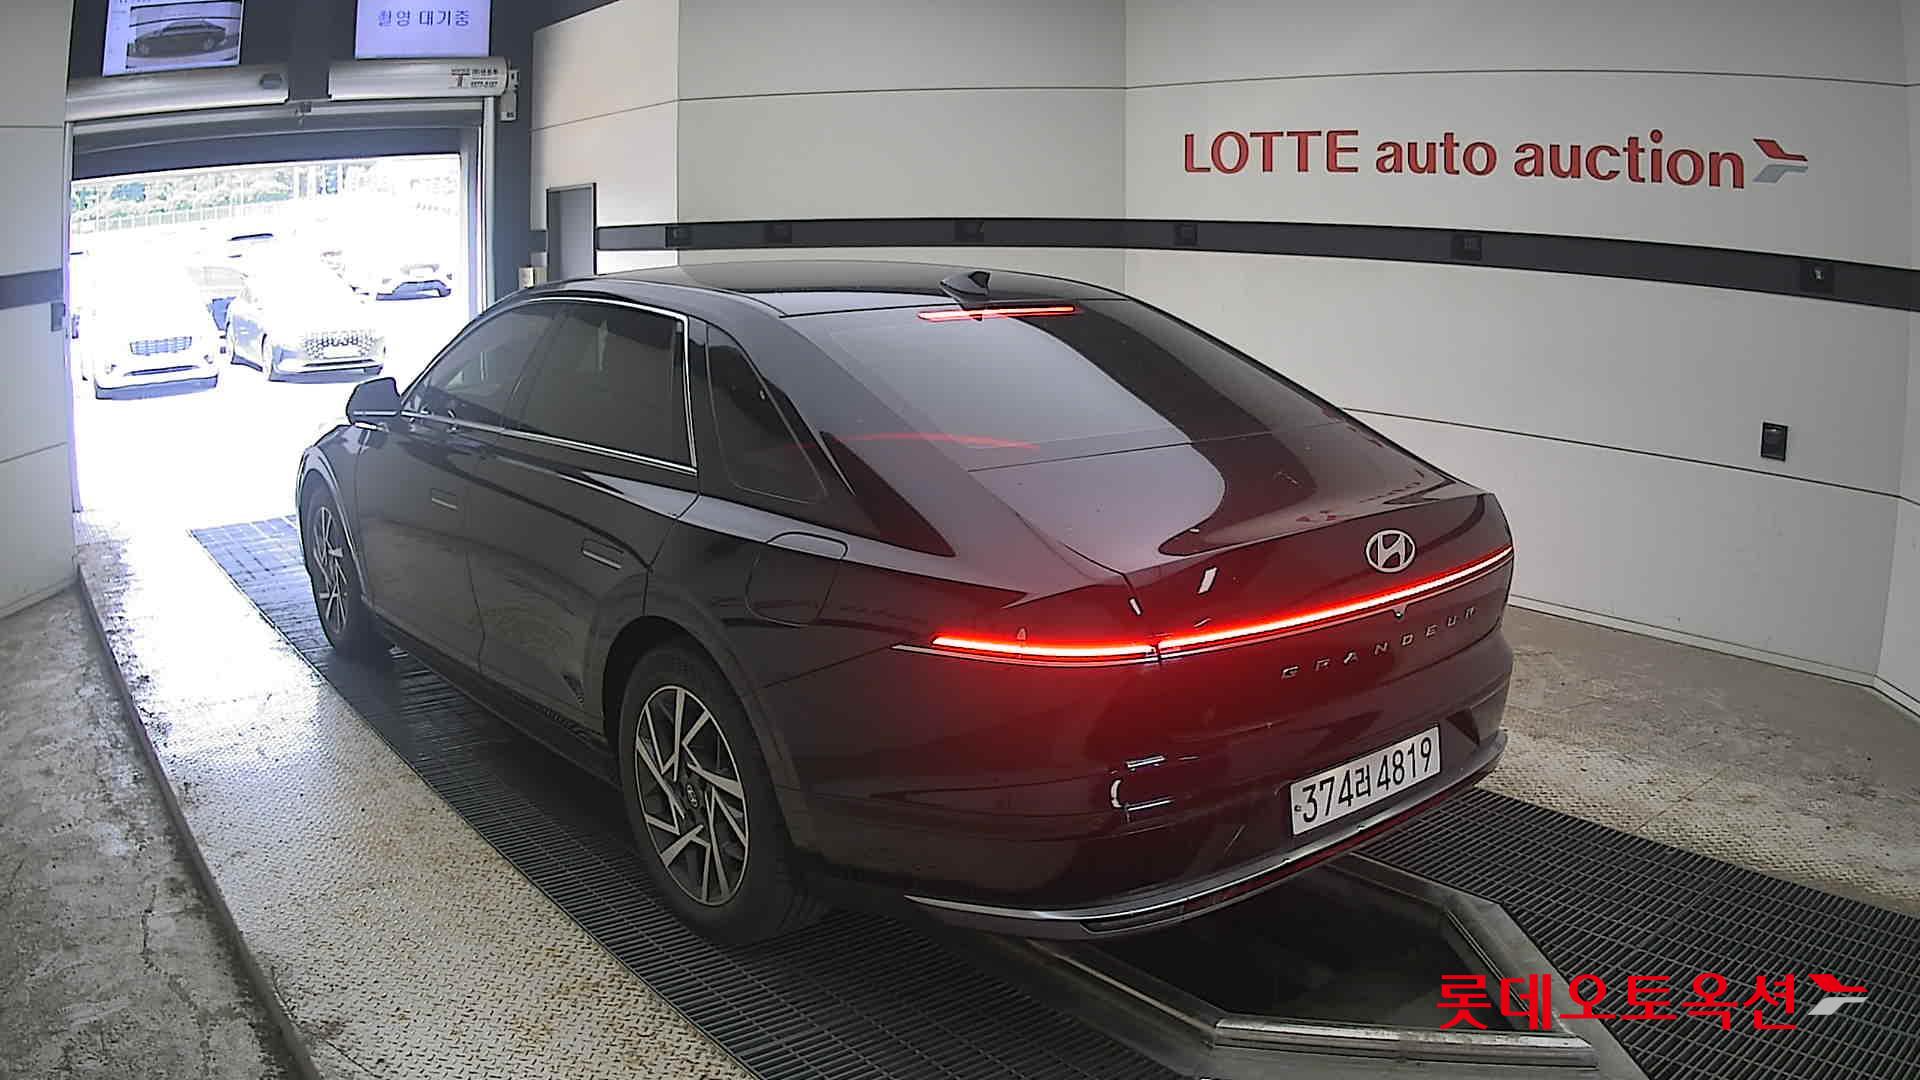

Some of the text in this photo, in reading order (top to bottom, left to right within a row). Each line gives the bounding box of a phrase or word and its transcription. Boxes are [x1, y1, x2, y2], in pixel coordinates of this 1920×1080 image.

[418, 9, 469, 27] 대기중
[1184, 128, 1745, 189] LOTTE auto auction
[1281, 606, 1477, 680] GRANDEUR
